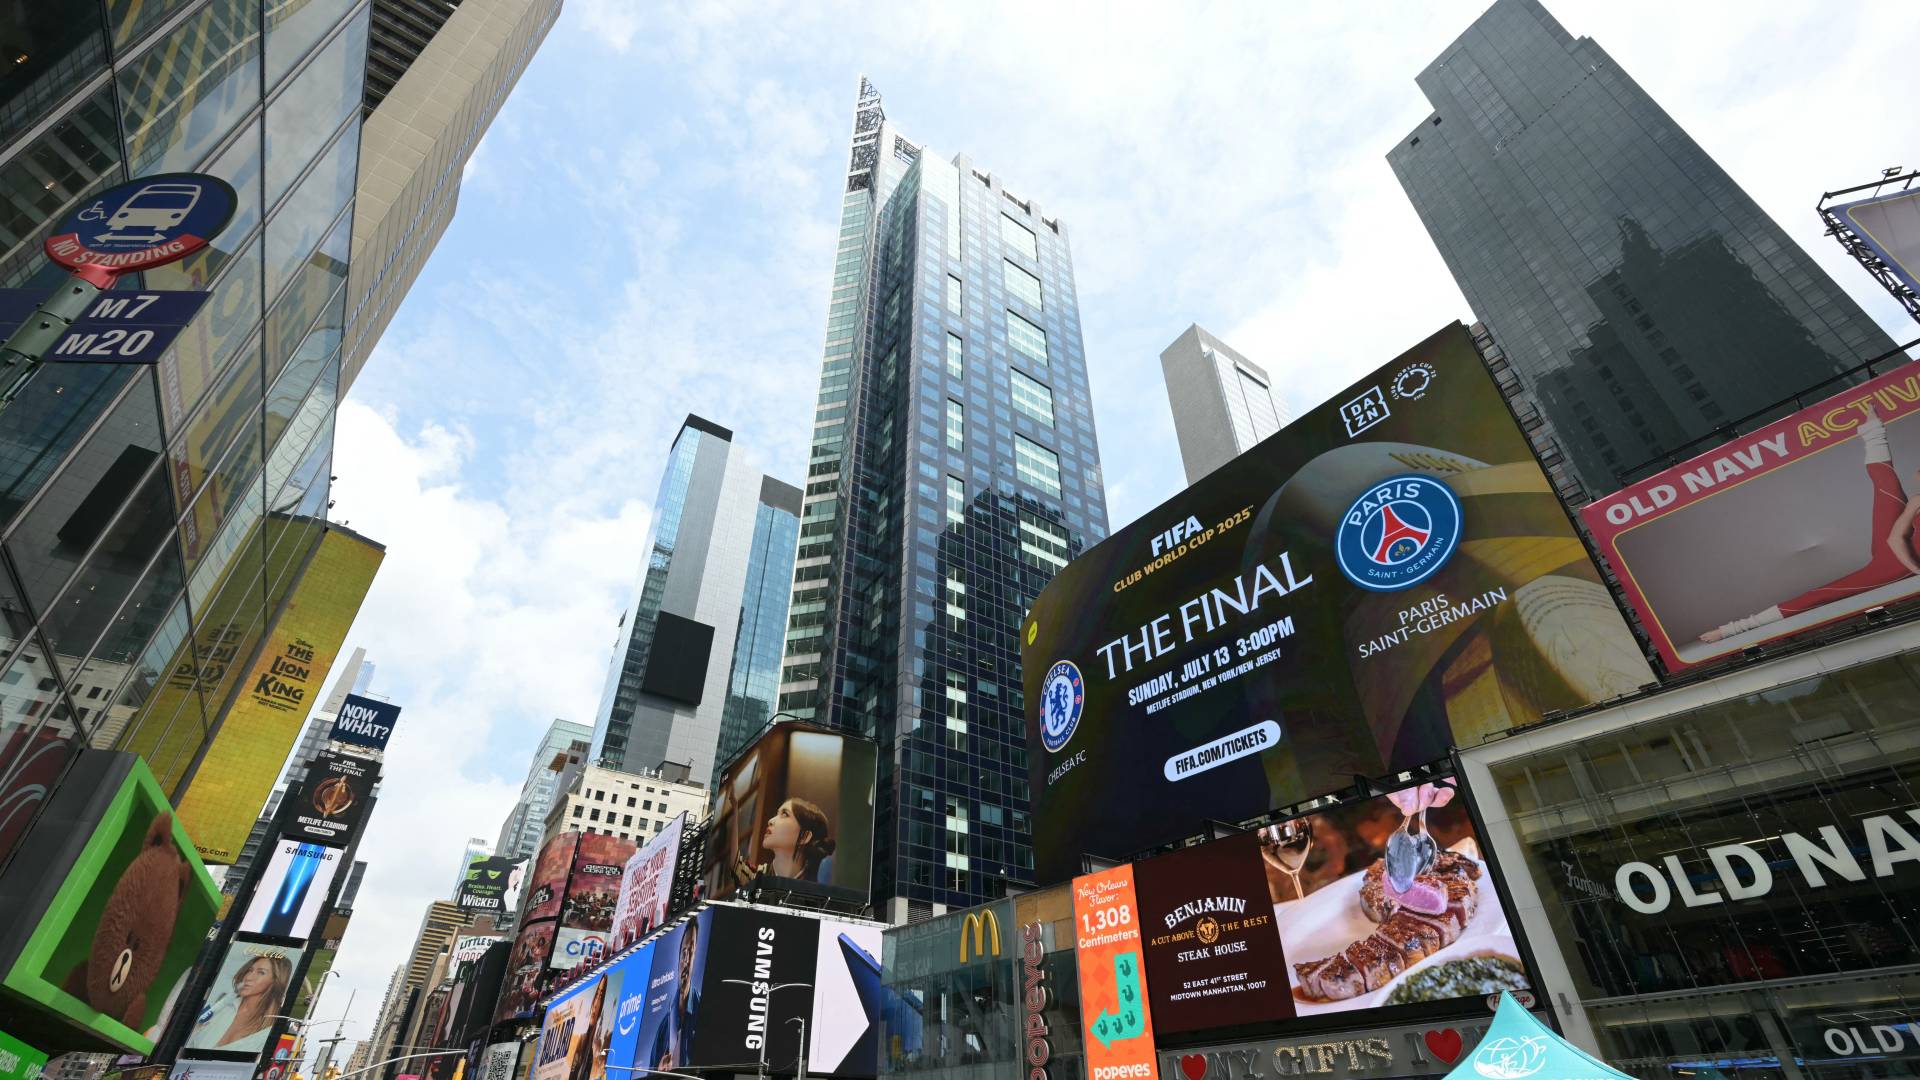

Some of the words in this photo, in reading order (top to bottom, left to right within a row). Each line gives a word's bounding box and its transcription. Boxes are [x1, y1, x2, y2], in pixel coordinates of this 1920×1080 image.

[53, 239, 79, 256] NO
[74, 241, 185, 264] STANDING
[89, 295, 160, 319] M7
[55, 329, 154, 356] M20
[1393, 363, 1417, 383] WORLD
[1606, 484, 1677, 526] OLD
[1681, 431, 1790, 494] NAVY
[1797, 374, 1920, 447] ACTIV
[1348, 482, 1421, 526] PARIS
[1151, 515, 1203, 557] FIFA
[1113, 571, 1142, 593] CLUB
[1144, 545, 1187, 575] WORLD
[1190, 528, 1215, 549] CUP
[1367, 567, 1397, 579] SAINT
[1406, 537, 1444, 574] GERMAIN
[1096, 613, 1176, 681] THE
[1179, 551, 1313, 642] FINAL
[1358, 586, 1508, 659] SAINT-GERMAIN
[1398, 594, 1449, 625] PARIS
[287, 644, 314, 661] THE
[1128, 671, 1179, 706] SUNDAY,
[1180, 653, 1210, 683] JULY
[1212, 646, 1231, 668] 13
[1236, 615, 1295, 657] 3:00PM
[270, 656, 310, 680] LION
[1043, 665, 1070, 695] CHELSEA
[1146, 693, 1172, 715] METLIFE
[1172, 682, 1202, 704] STADIUM,
[1202, 674, 1217, 691] NEW
[1217, 660, 1254, 684] YORK/NEW
[1255, 648, 1281, 667] JERSEY
[254, 673, 305, 700] KING
[338, 716, 389, 739] WHAT?
[342, 704, 378, 722] NOW
[1065, 717, 1077, 735] CLUB
[1175, 728, 1268, 775] FIFA.COM/TICKETS
[329, 765, 342, 773] THE
[343, 768, 362, 777] FINAL
[1048, 758, 1075, 786] CHELSEA
[1075, 749, 1087, 765] FC
[297, 816, 322, 826] METLIFE
[322, 820, 348, 831] STADIUM
[285, 847, 334, 861] SAMSUNG
[1615, 843, 1773, 915] OLD
[1781, 809, 1920, 889] NA
[1078, 882, 1096, 899] New
[1096, 879, 1128, 894] Orleans
[1089, 893, 1119, 908] Flavor:
[1082, 904, 1131, 935] 1,308
[1164, 896, 1247, 930] BENJAMIN
[460, 938, 486, 950] LITTLE
[1079, 928, 1139, 949] Centimeters
[1151, 938, 1158, 947] A
[1157, 935, 1171, 946] CUT
[1171, 930, 1196, 943] ABOVE
[1220, 922, 1240, 932] THE
[1243, 915, 1269, 928] REST
[1177, 948, 1210, 963] STEAK
[1214, 941, 1248, 956] HOUSE
[745, 927, 775, 1050] SAMSUNG
[1170, 990, 1201, 1001] MIDTOWN
[1202, 984, 1246, 998] MANHATTAN,
[1246, 980, 1267, 991] 10017
[1183, 981, 1191, 990] 52
[1192, 979, 1209, 988] EAST
[1222, 972, 1248, 983] STREET
[619, 993, 642, 1023] prime
[1207, 1048, 1258, 1080] NY
[1273, 1036, 1392, 1076] GIFTS
[1403, 1031, 1430, 1066] I
[1824, 1025, 1904, 1056] OLD
